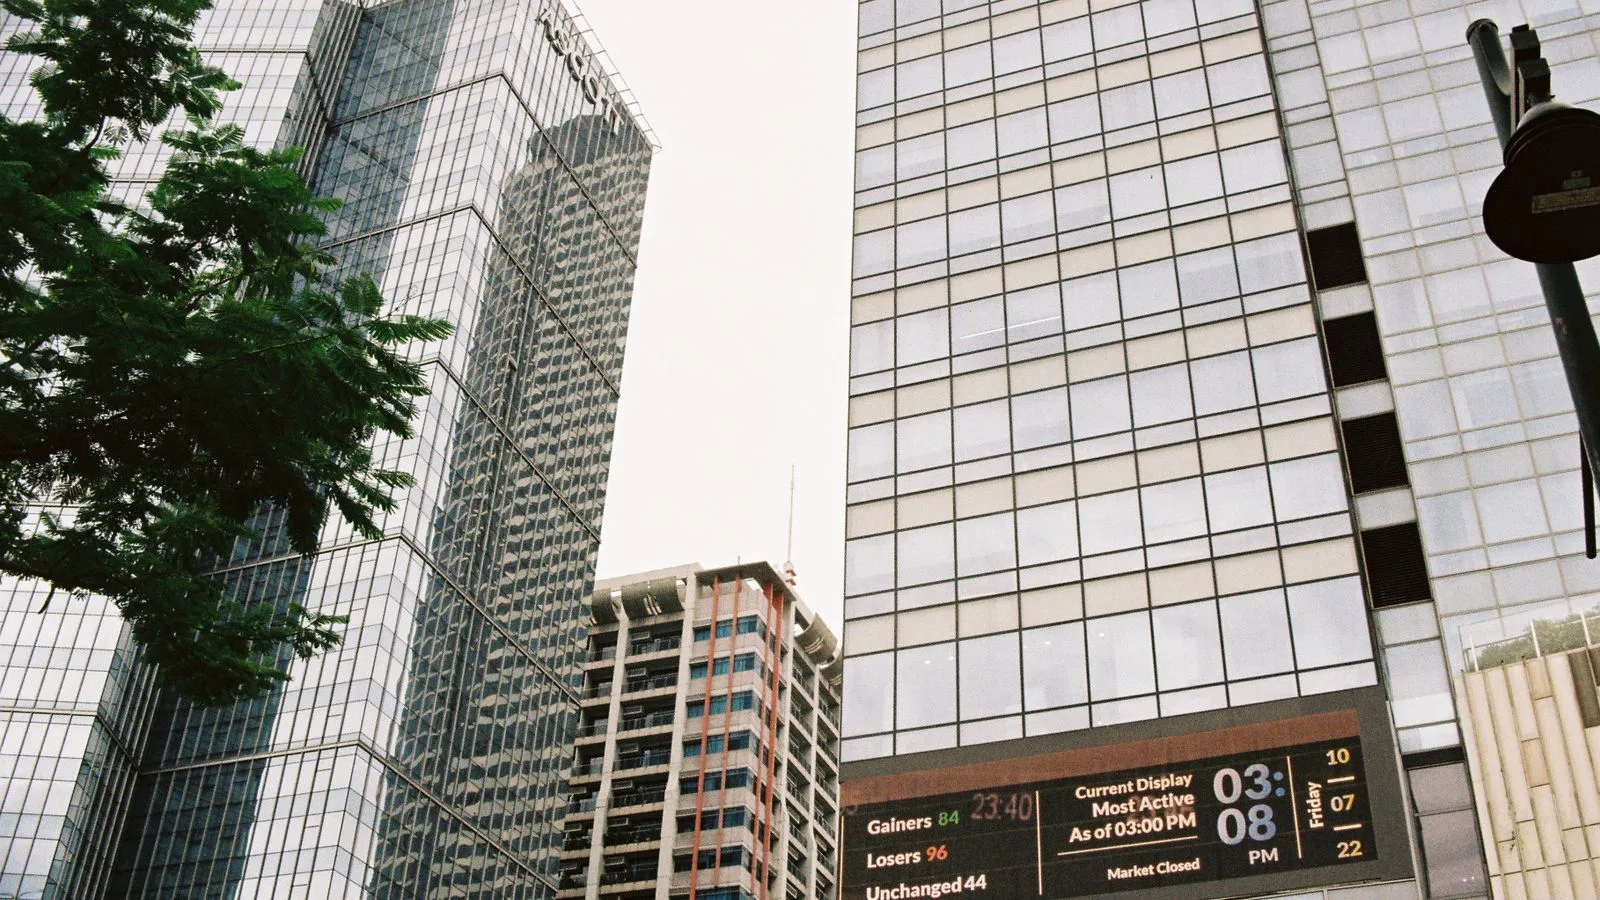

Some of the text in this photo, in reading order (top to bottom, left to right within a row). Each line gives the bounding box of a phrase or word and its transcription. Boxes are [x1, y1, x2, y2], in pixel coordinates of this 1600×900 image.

[535, 8, 625, 136] ASCOTT
[1326, 748, 1351, 766] 10
[1075, 773, 1193, 799] Current Display
[1092, 793, 1194, 818] Most Active
[1306, 781, 1324, 829] Friday
[1330, 794, 1355, 812] 07
[867, 810, 960, 834] Gainers 84
[1069, 812, 1197, 843] As of 03:00 PM
[1216, 804, 1276, 845] 08
[867, 844, 949, 869] Losers 96
[1248, 847, 1279, 865] PM
[1337, 840, 1363, 859] 22
[1107, 858, 1200, 880] Market Closed
[866, 874, 987, 900] Unchanged 44
